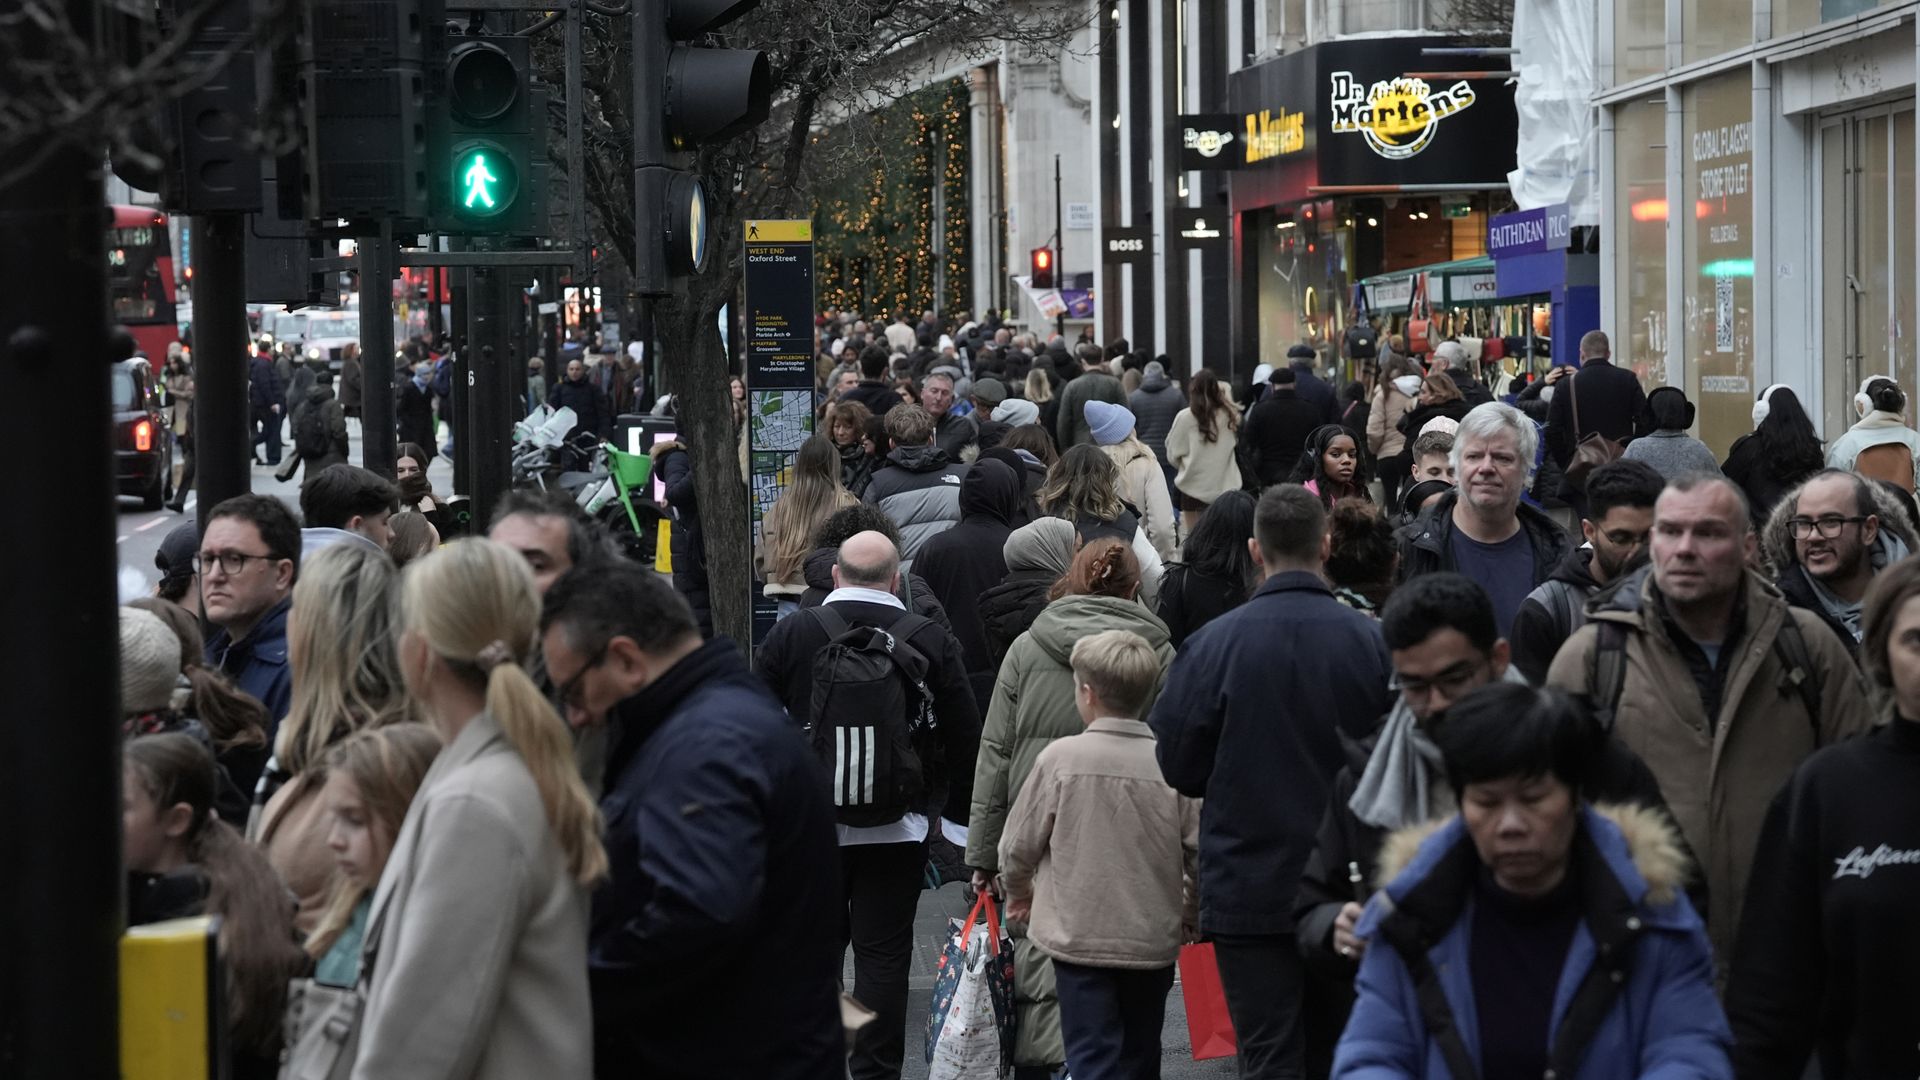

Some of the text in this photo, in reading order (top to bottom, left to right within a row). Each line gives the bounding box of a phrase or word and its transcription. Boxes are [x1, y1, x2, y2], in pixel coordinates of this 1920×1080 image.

[1332, 72, 1363, 101] Dr.
[1333, 81, 1475, 131] Martens
[1694, 130, 1720, 161] GLOBAL
[1701, 163, 1748, 199] STORE TO LET
[1109, 239, 1144, 252] BOSS
[1491, 214, 1567, 248] FAITHDEAN PLC
[769, 247, 784, 255] END
[468, 370, 475, 387] 6
